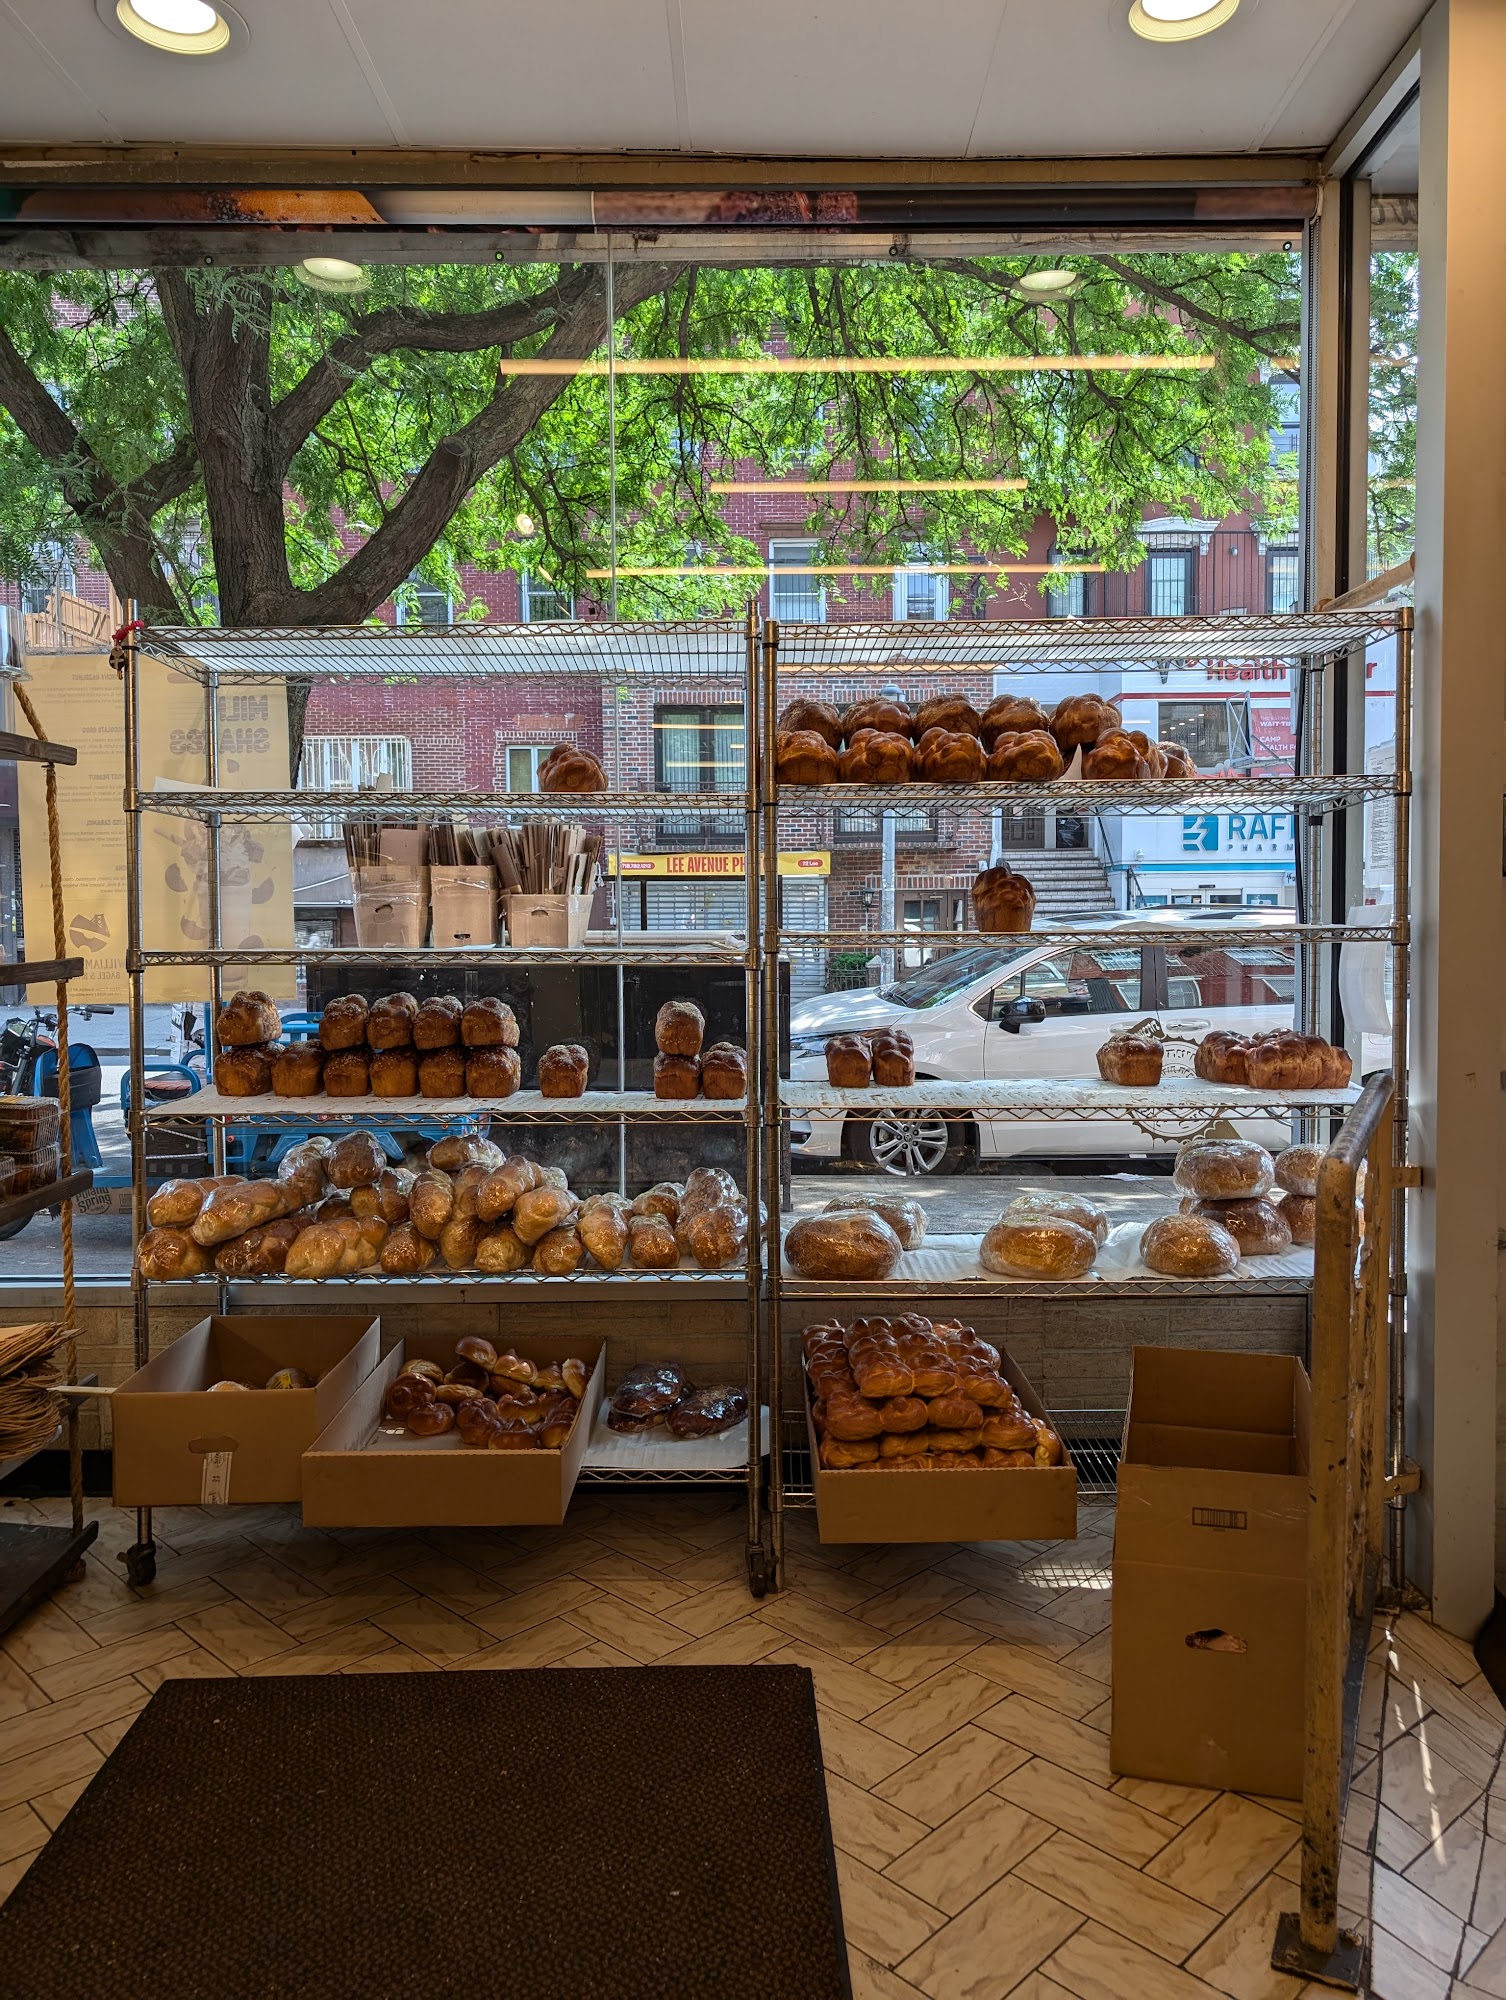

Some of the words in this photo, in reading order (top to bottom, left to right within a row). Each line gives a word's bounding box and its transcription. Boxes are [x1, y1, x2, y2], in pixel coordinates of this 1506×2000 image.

[1207, 657, 1287, 681] Health
[1227, 844, 1294, 852] PHARM
[666, 857, 685, 873] LEE
[687, 857, 730, 873] AVENUE
[77, 1194, 113, 1213] Spring
